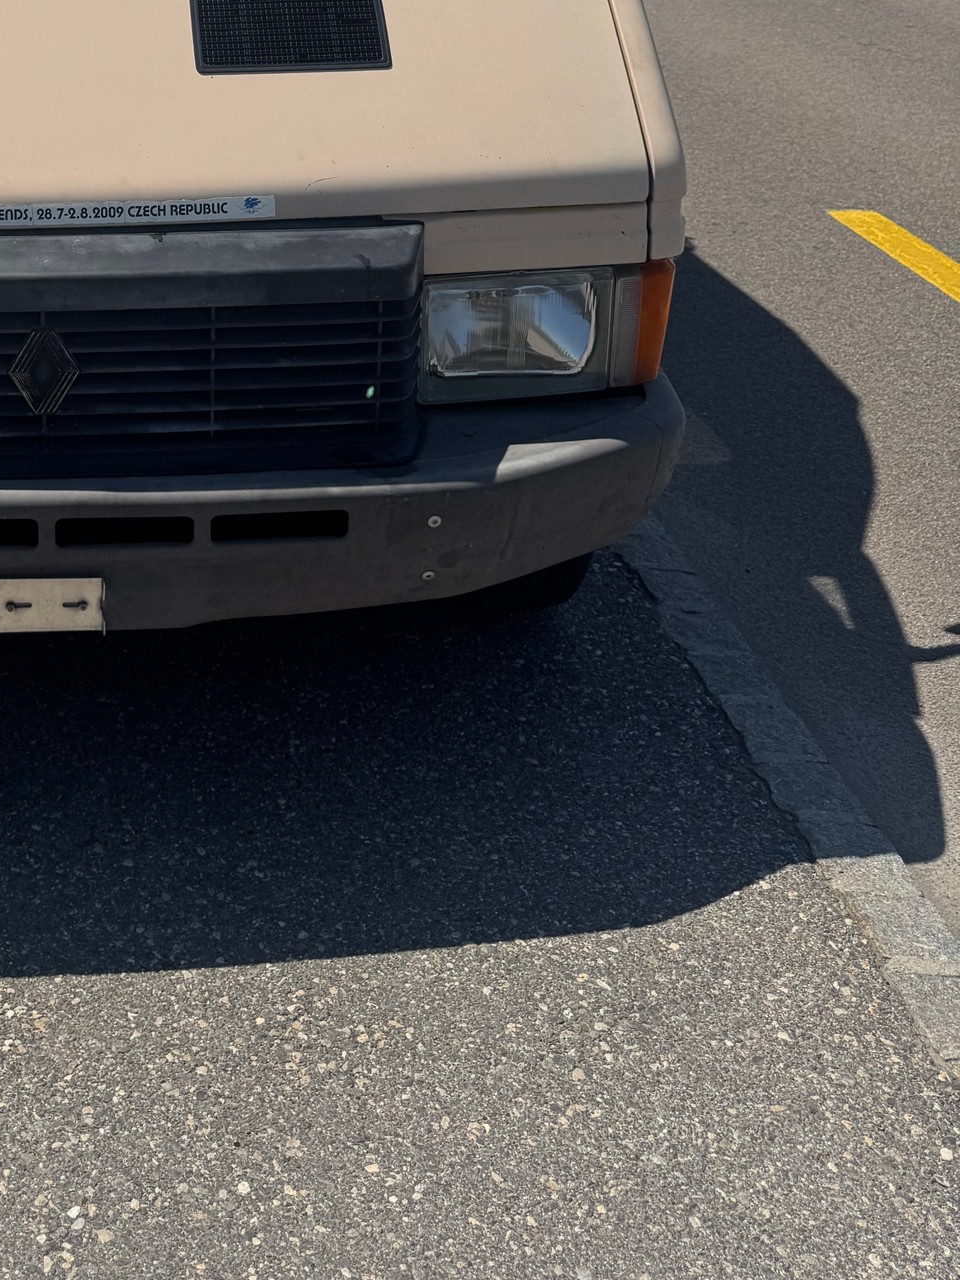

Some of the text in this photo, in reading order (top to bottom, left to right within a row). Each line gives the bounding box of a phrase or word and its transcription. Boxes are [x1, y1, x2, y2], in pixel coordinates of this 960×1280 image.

[36, 206, 124, 220] 28.7-2.8.2009
[127, 204, 167, 218] CZECH
[169, 202, 229, 217] REPUBLIC
